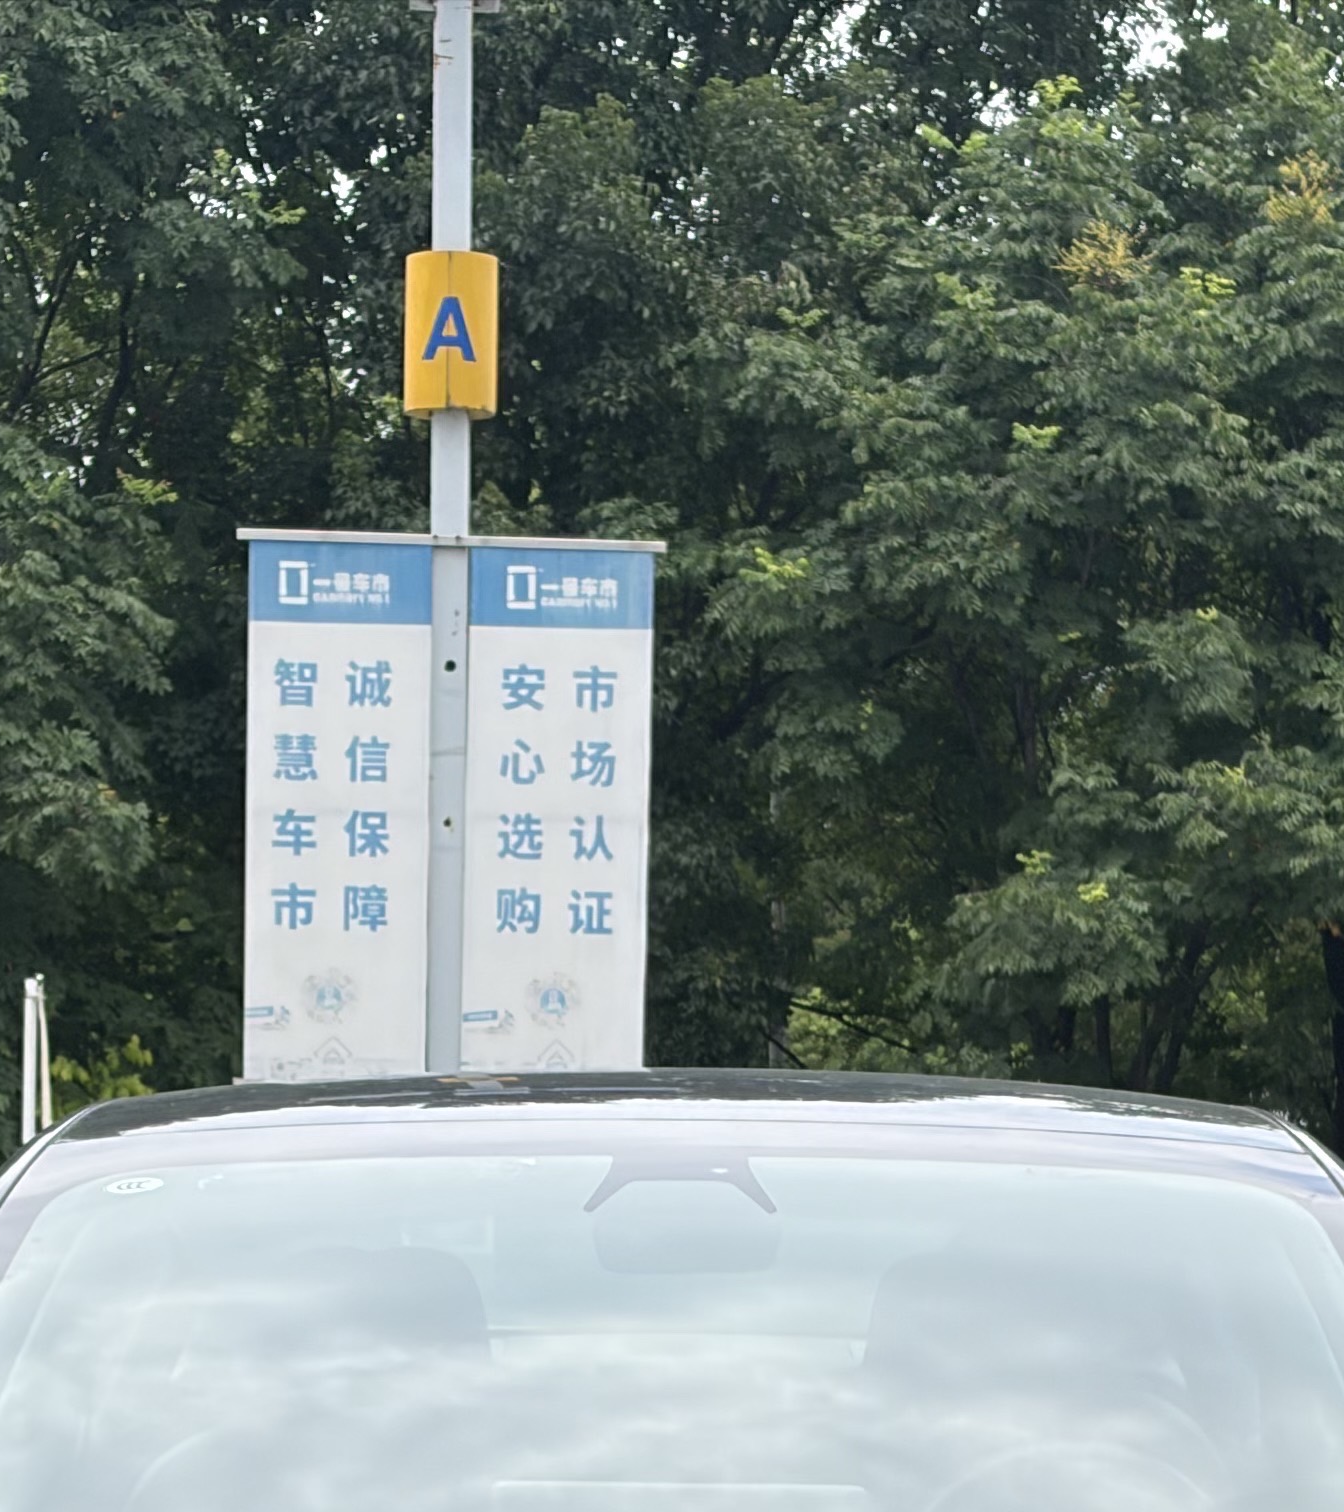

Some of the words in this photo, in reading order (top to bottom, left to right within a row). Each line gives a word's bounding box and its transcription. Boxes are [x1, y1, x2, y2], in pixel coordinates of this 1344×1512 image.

[421, 296, 477, 362] A
[270, 659, 319, 931] 智慧车市
[342, 660, 393, 933] 诚信保障
[495, 664, 546, 934] 安心选购
[568, 665, 618, 936] 市场认证
